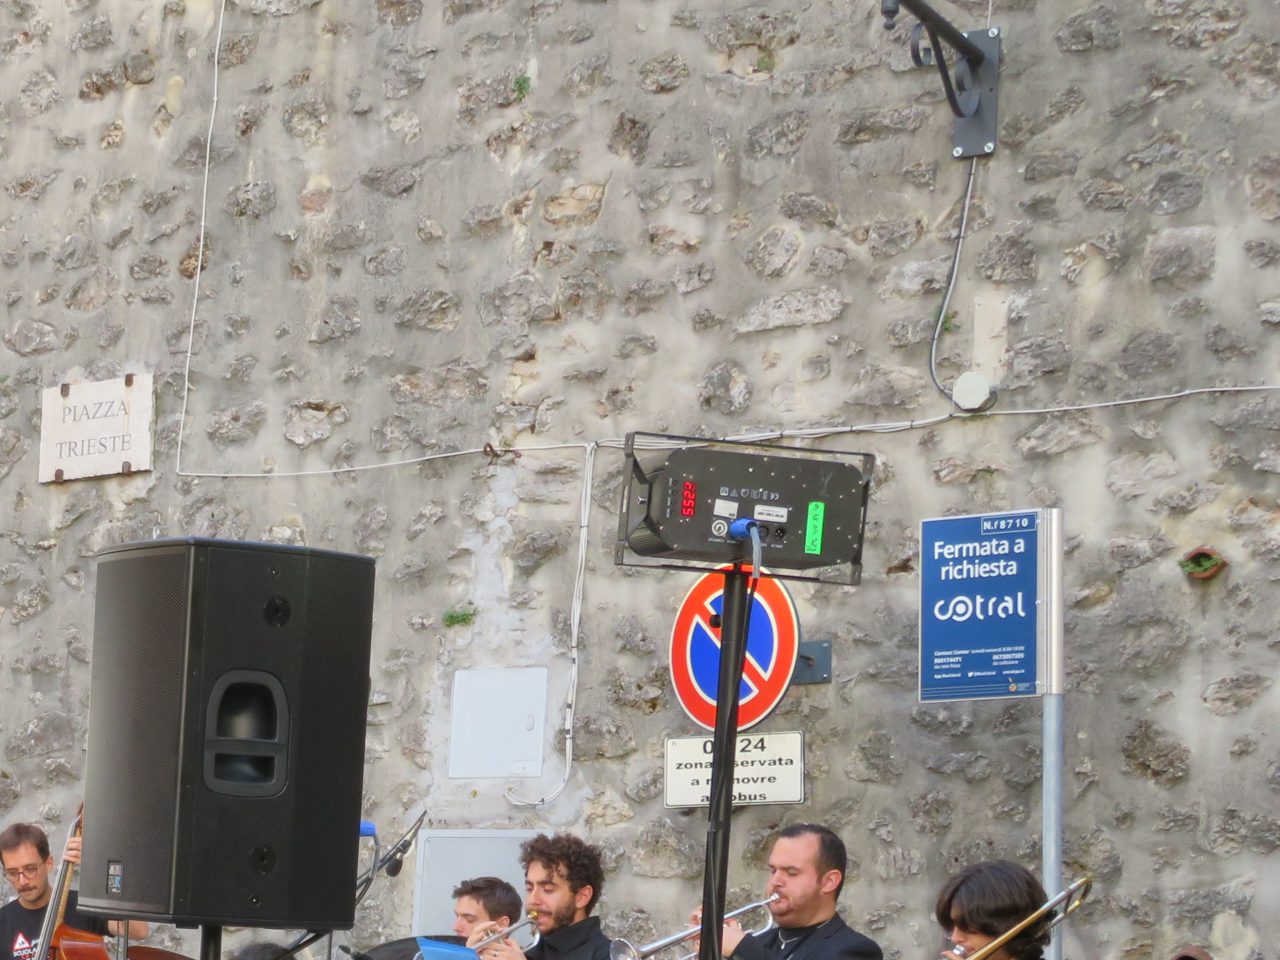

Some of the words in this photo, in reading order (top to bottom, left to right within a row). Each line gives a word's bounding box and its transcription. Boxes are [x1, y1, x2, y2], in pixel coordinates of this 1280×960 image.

[62, 399, 128, 423] PIAZZA
[55, 434, 132, 459] TRIESTE
[933, 538, 1009, 560] Fermata
[1013, 538, 1025, 554] a
[940, 559, 1018, 581] richiesta
[933, 591, 1026, 622] cotral
[690, 778, 700, 786] a
